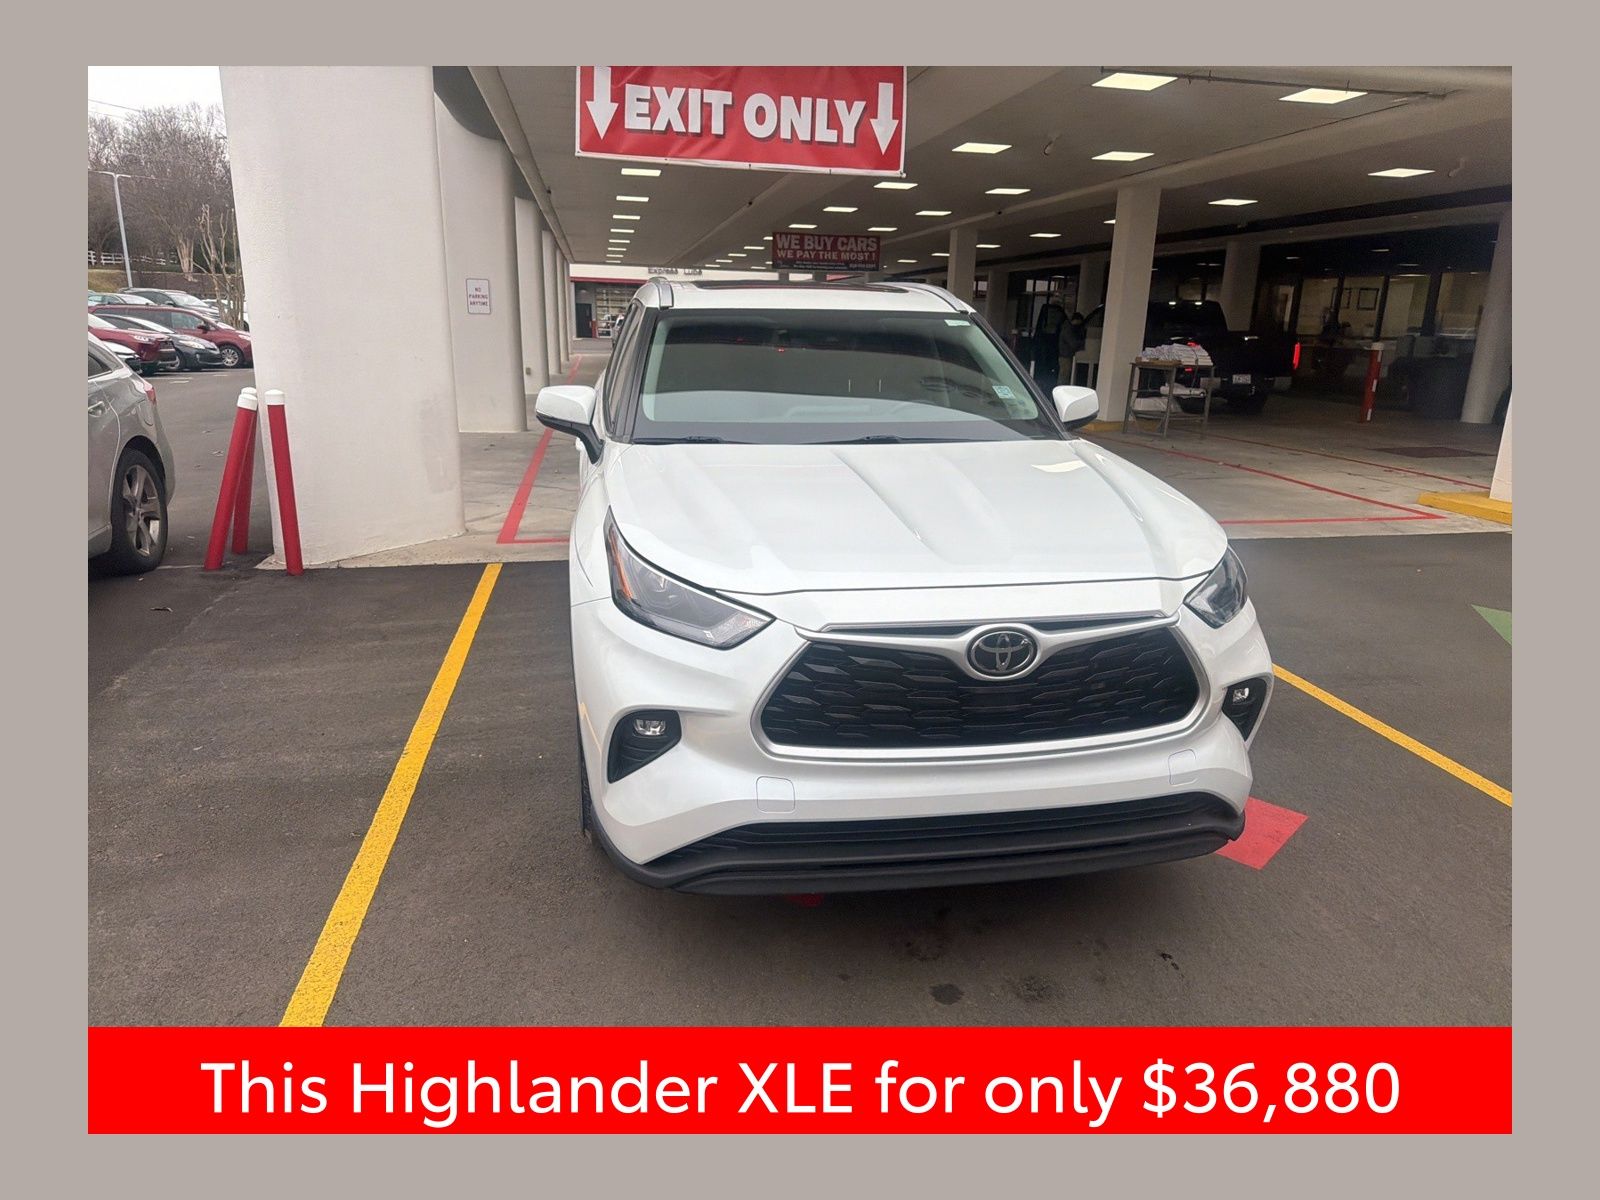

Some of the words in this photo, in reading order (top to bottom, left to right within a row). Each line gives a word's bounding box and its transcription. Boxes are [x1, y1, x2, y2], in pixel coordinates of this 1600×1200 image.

[624, 83, 733, 136] EXIT
[743, 92, 867, 145] ONLY
[776, 234, 800, 249] WE
[804, 235, 835, 250] BUY
[837, 237, 878, 252] CARS
[777, 249, 794, 259] WE
[796, 250, 818, 259] PAY
[819, 251, 839, 260] THE
